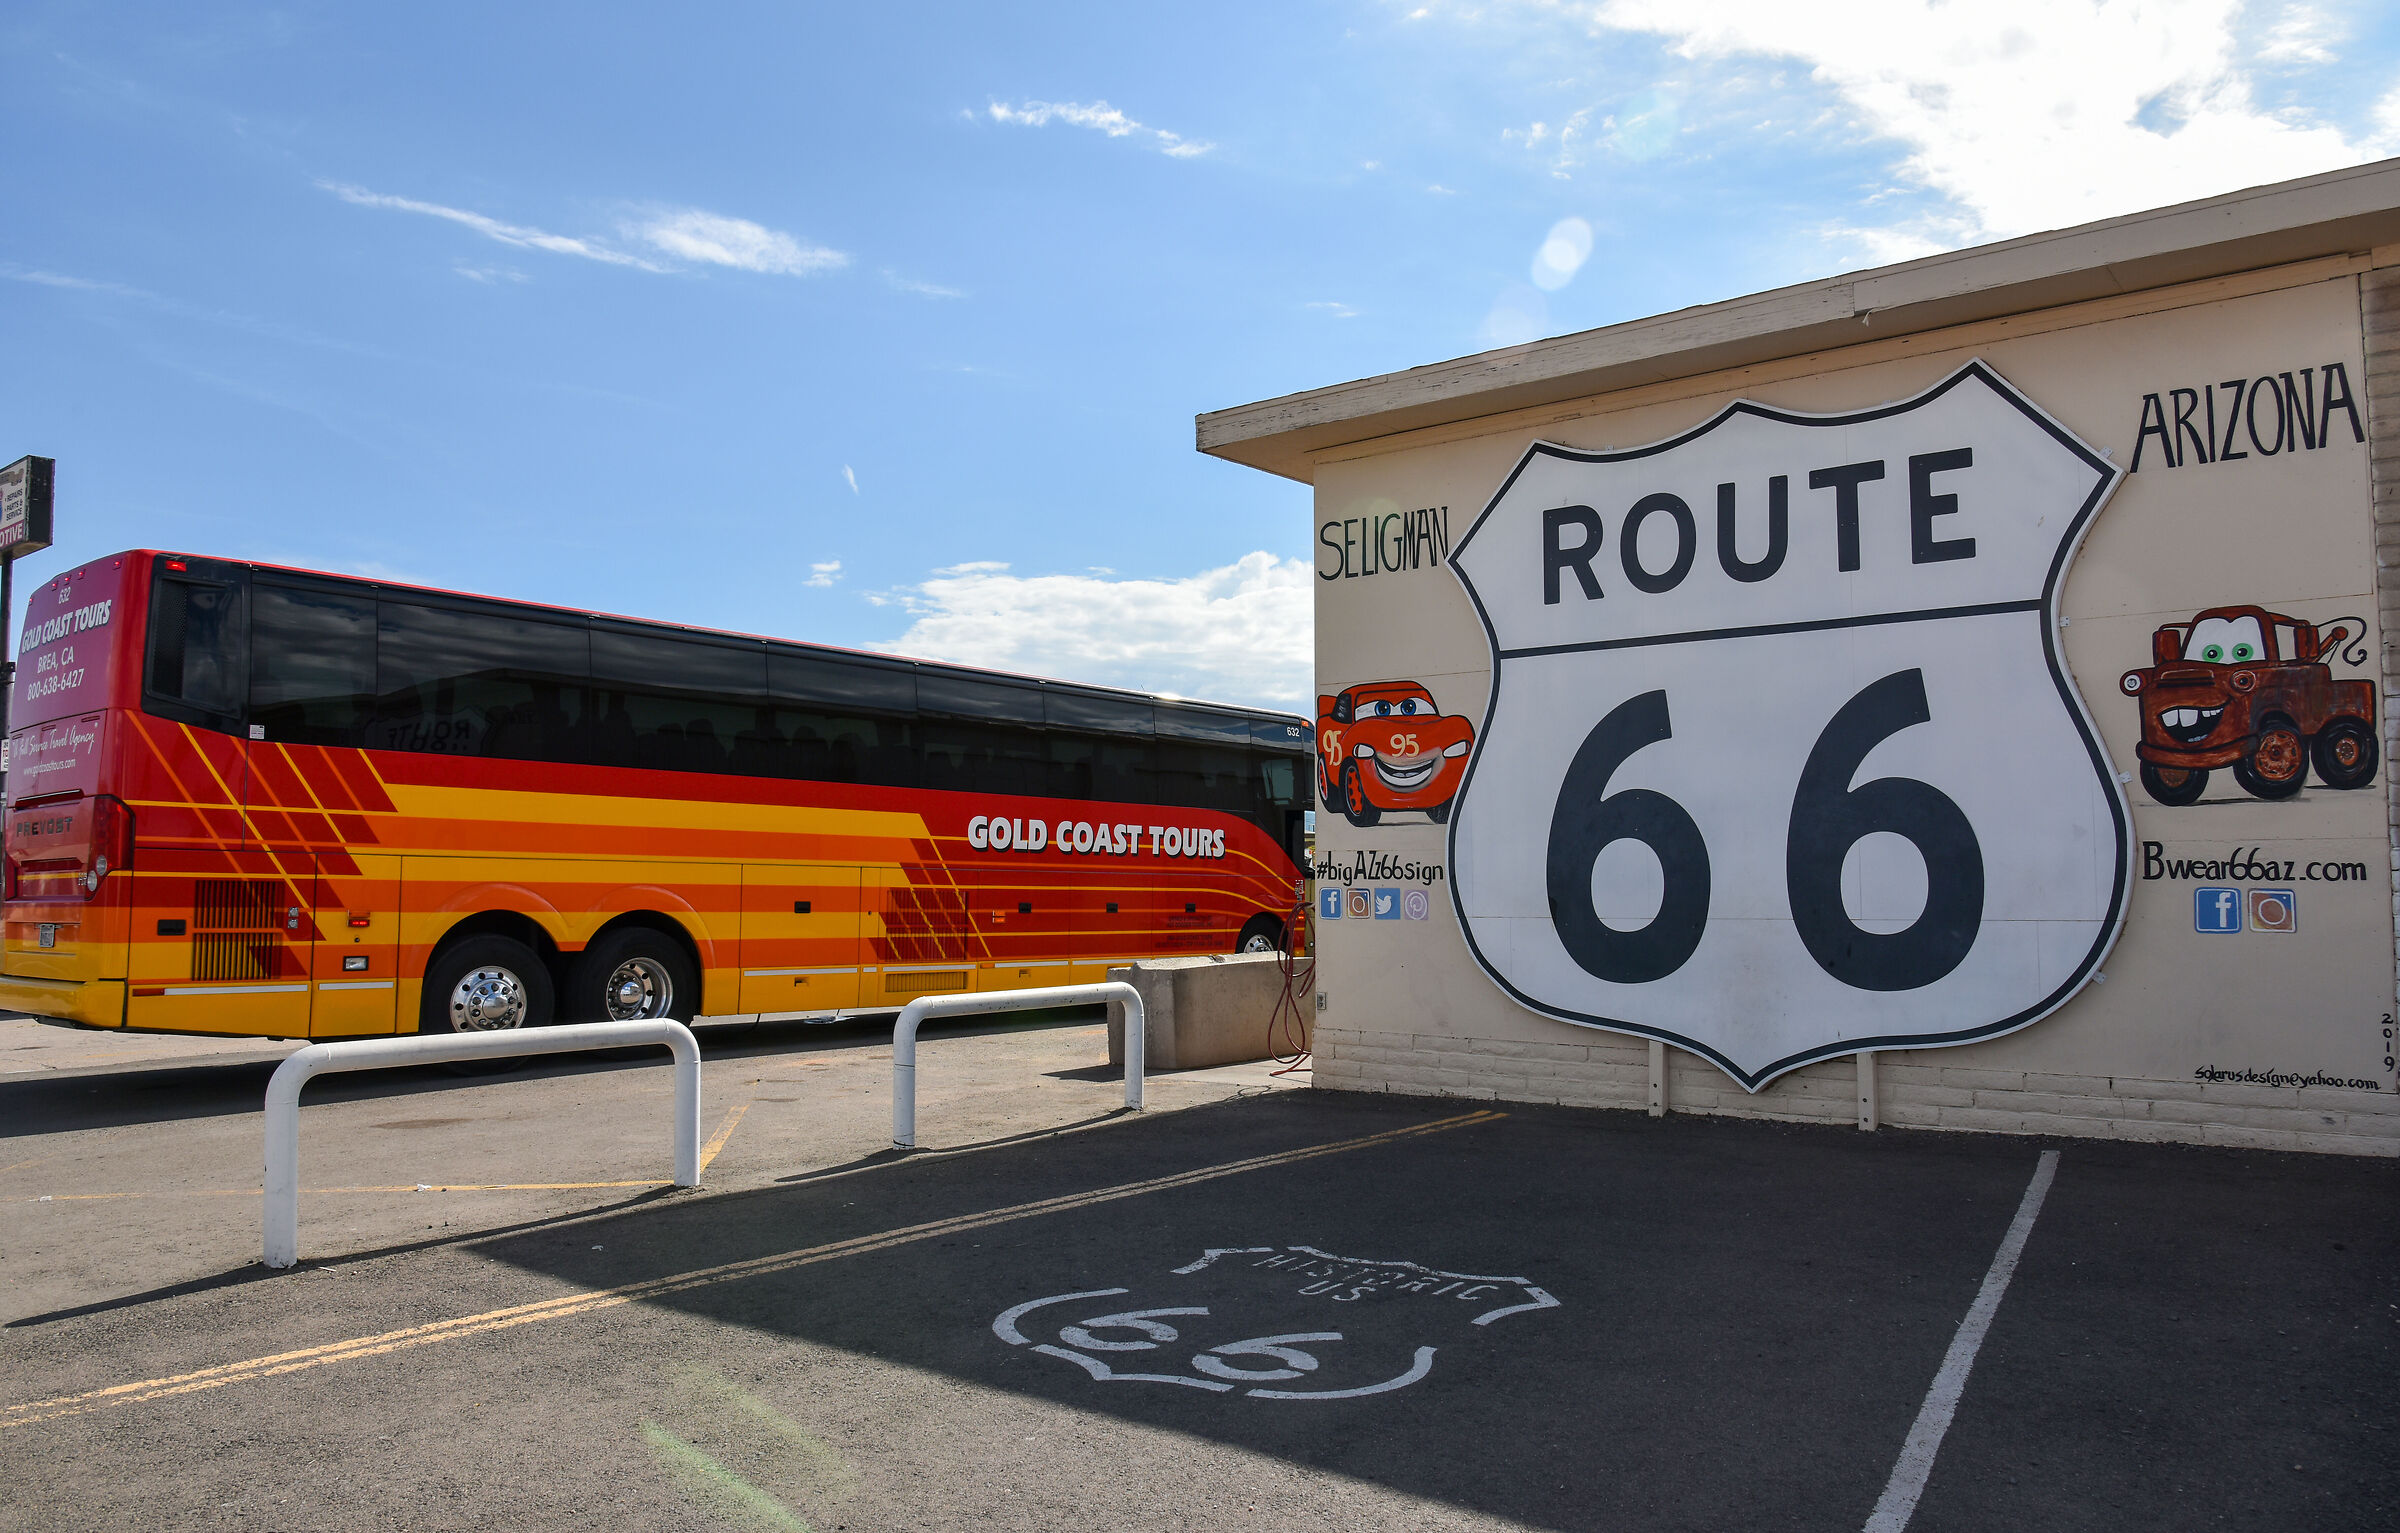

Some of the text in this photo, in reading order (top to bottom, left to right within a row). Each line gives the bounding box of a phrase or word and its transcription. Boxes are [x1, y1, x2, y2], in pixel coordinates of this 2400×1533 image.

[2130, 362, 2365, 473] ARIZONA
[6, 508, 22, 521] SERVICE
[1542, 446, 1977, 605] ROUTE
[1318, 506, 1448, 581] SELIGMAN
[59, 587, 71, 604] 632
[22, 600, 112, 653] GOLD COAST TOURS
[37, 646, 74, 673] BREA, CA
[27, 668, 84, 701] 800-638-6427
[1286, 726, 1300, 737] 632
[1323, 730, 1342, 766] 95
[1390, 733, 1420, 758] 95
[16, 816, 73, 837] PREVOST
[967, 815, 1226, 858] GOLD COAST TOURS
[1546, 667, 1985, 992] 66
[2142, 841, 2367, 881] Bwear66az.com
[1252, 1254, 1499, 1301] HISTORIC
[1298, 1281, 1377, 1301] US
[1058, 1306, 1343, 1381] 66
